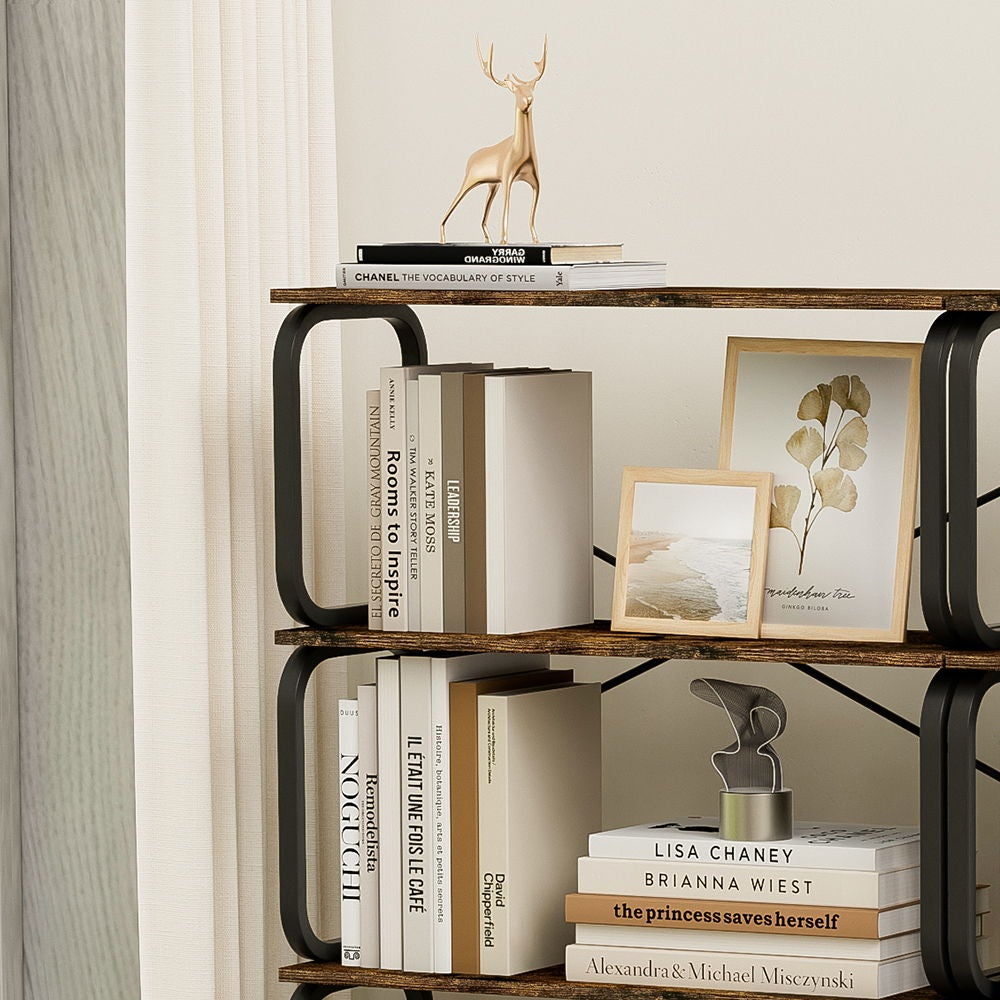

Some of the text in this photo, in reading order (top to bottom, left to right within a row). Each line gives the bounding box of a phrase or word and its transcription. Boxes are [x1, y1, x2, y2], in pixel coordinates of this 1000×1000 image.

[354, 272, 400, 282] CHANEL
[401, 273, 420, 282] THE
[422, 273, 488, 282] VOCABULARY
[490, 273, 503, 282] OF
[506, 274, 535, 283] STYLE
[369, 406, 383, 619] EL SECRETO DE GRAY MOUNTAIN
[384, 450, 403, 618] Rooms to Inspire
[409, 447, 418, 580] TIM WALKER STORY TELLER
[425, 470, 436, 553] KATE MOSS
[447, 480, 460, 542] LEADERSHIP
[340, 753, 361, 901] NOGUCHI
[366, 774, 380, 875] Remodelista
[407, 736, 427, 913] IL ÉTAIT UNE FOIS LE CAFÉ
[655, 842, 793, 863] LISA CHANEY
[482, 872, 495, 947] Chipperfield
[495, 873, 506, 907] David
[613, 902, 840, 930] the princess saves herself
[645, 872, 812, 894] BRIANNA WIEST
[585, 956, 669, 978] Alexandra
[688, 961, 755, 983] Michael
[761, 966, 853, 989] Misczynski
